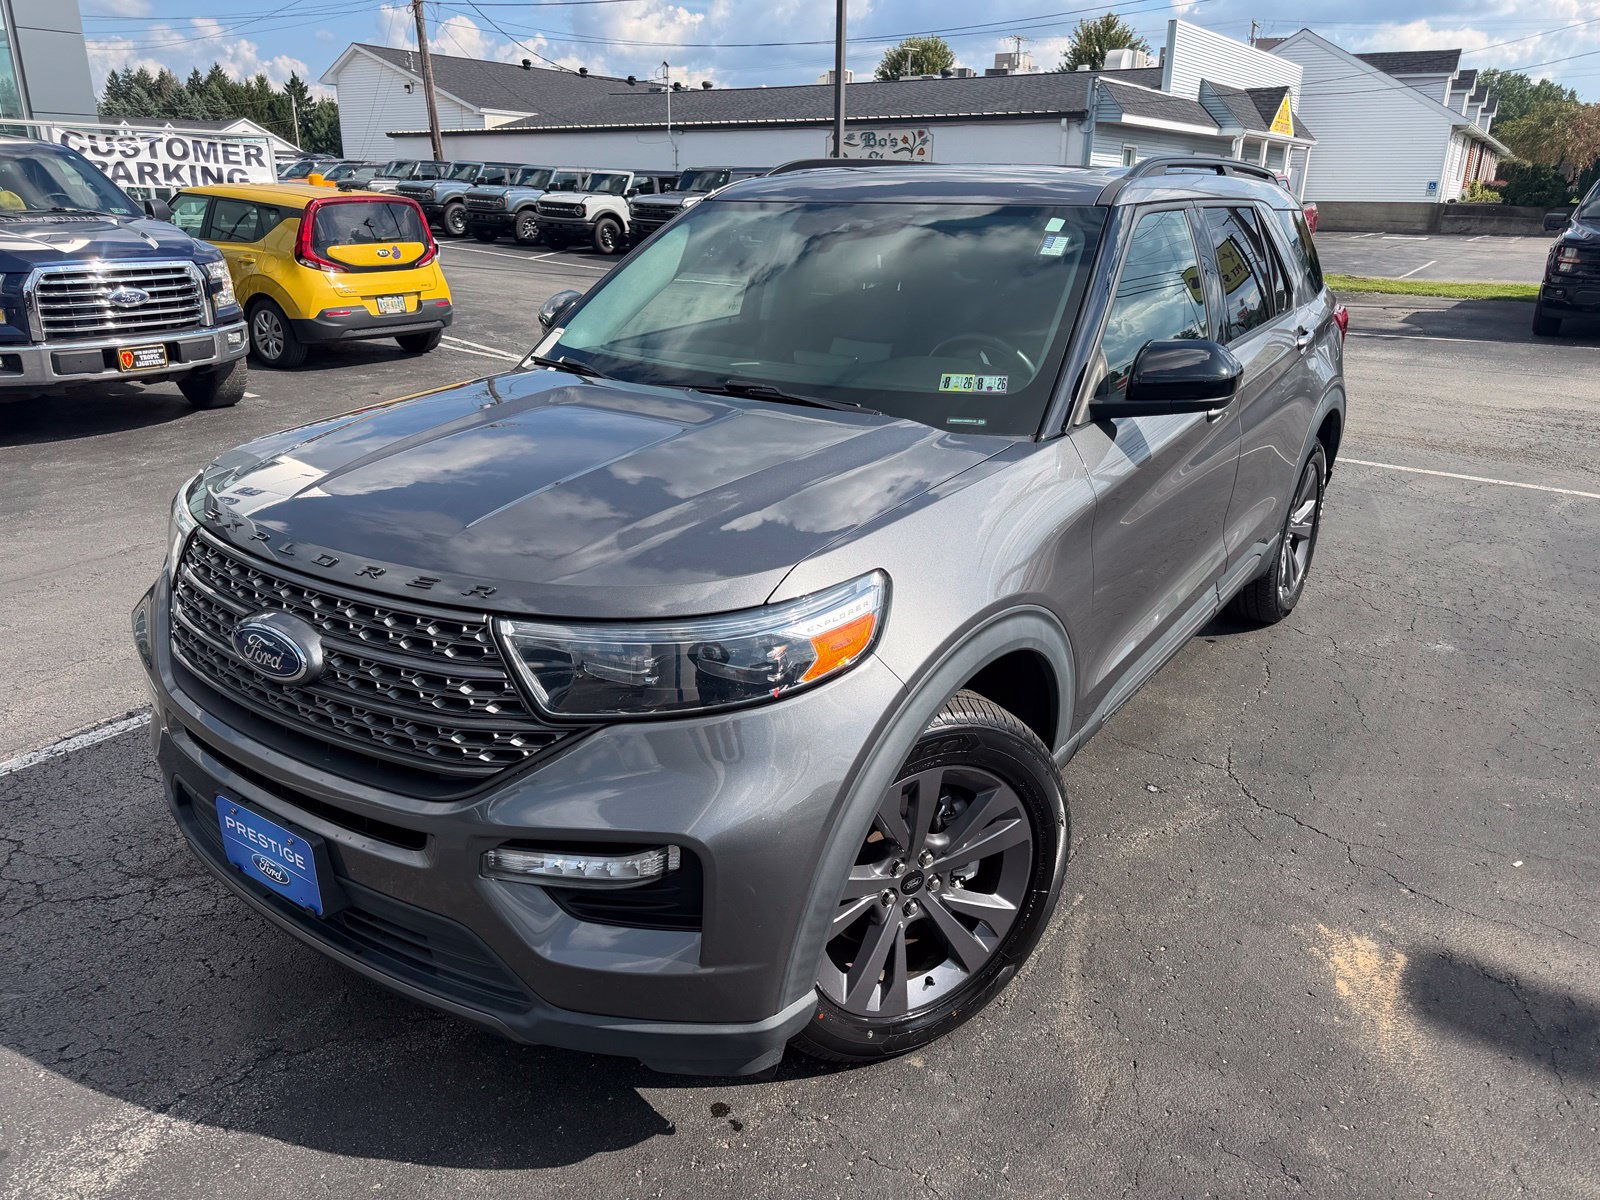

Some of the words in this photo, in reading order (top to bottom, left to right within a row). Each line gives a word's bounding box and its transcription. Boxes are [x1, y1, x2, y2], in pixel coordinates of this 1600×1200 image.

[60, 130, 267, 168] CUSTOMER
[860, 131, 899, 149] Bo's
[135, 358, 166, 367] LIGHTNING
[139, 353, 161, 361] TROPIC
[963, 376, 973, 389] 26
[996, 377, 1007, 390] 26
[204, 507, 498, 599] EXPLORER
[807, 600, 869, 633] EXPLORER
[244, 633, 285, 670] Ford
[224, 815, 307, 871] PRESTIGE
[258, 856, 283, 881] Ford
